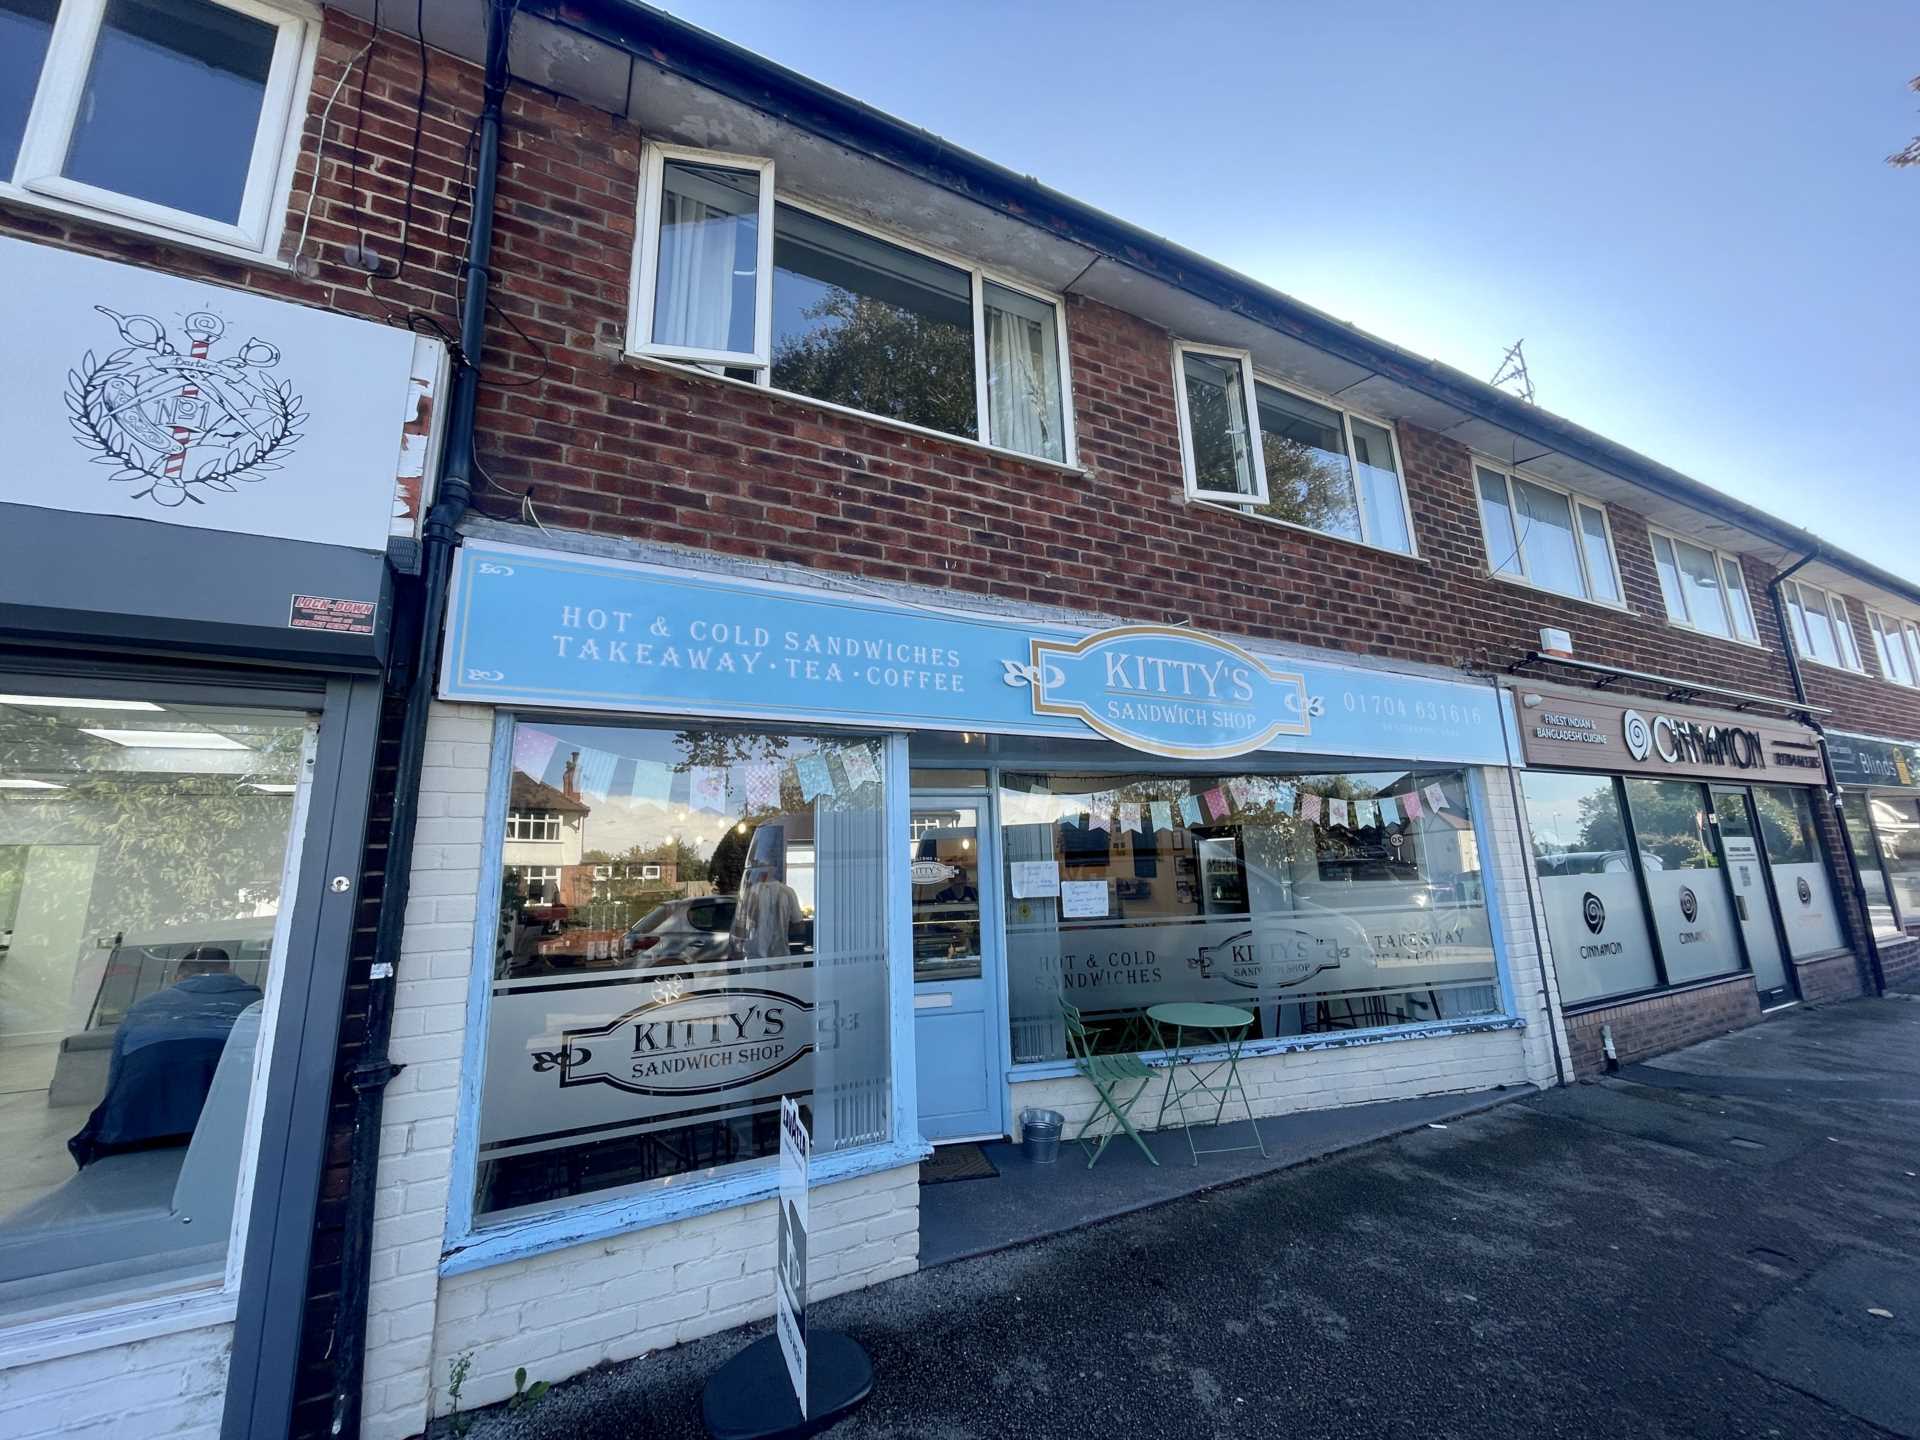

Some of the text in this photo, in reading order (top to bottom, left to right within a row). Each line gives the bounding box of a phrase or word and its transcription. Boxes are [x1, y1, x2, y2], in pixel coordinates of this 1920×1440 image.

[562, 606, 960, 668] HOT & COLD SANDWICHES
[1104, 651, 1254, 701] KITTY'S
[1108, 700, 1257, 730] SANDWICH SHOP
[1343, 691, 1407, 717] 01704
[1544, 713, 1568, 727] FINEST
[1567, 716, 1591, 729] INDIAN
[1536, 728, 1607, 744] BANGLADESHI CUISINE
[1653, 716, 1767, 769] CINNAMON
[1859, 752, 1897, 777] Blinds
[1374, 928, 1464, 950] TAKEAWAY
[1580, 942, 1623, 959] CINNAMON
[1039, 950, 1155, 970] HOT & COLD
[1035, 968, 1162, 990] SANDWICHES
[632, 1004, 785, 1054] KITTY'S
[632, 1044, 784, 1079] SANDWICH SHOP
